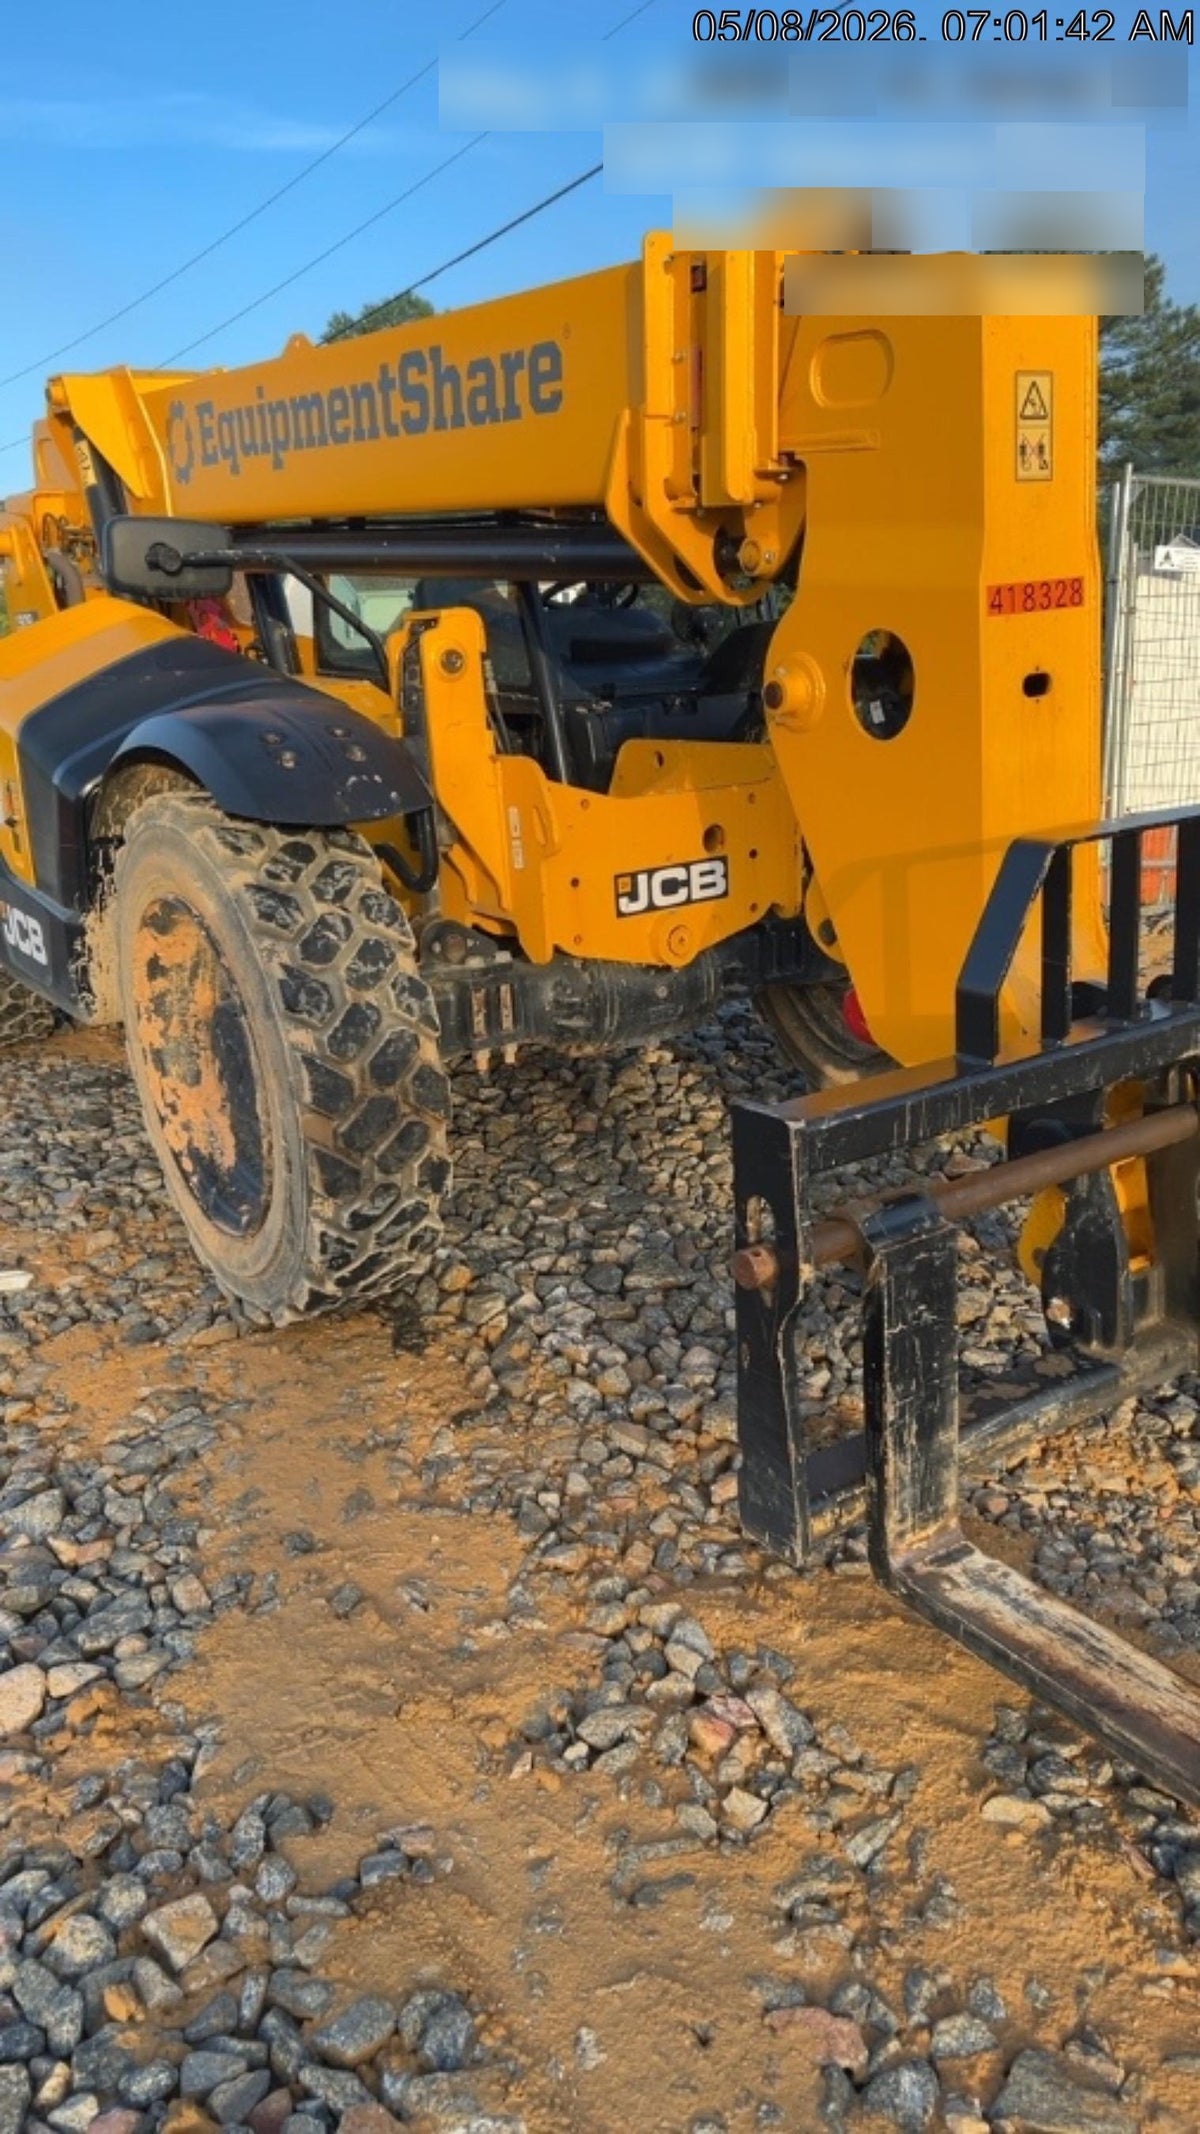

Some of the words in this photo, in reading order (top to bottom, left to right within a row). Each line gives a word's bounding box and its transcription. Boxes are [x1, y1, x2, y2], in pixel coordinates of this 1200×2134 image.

[196, 340, 563, 475] EquipmentShare
[990, 578, 1083, 614] 418328
[618, 860, 727, 914] JCB
[4, 907, 49, 967] JCB
